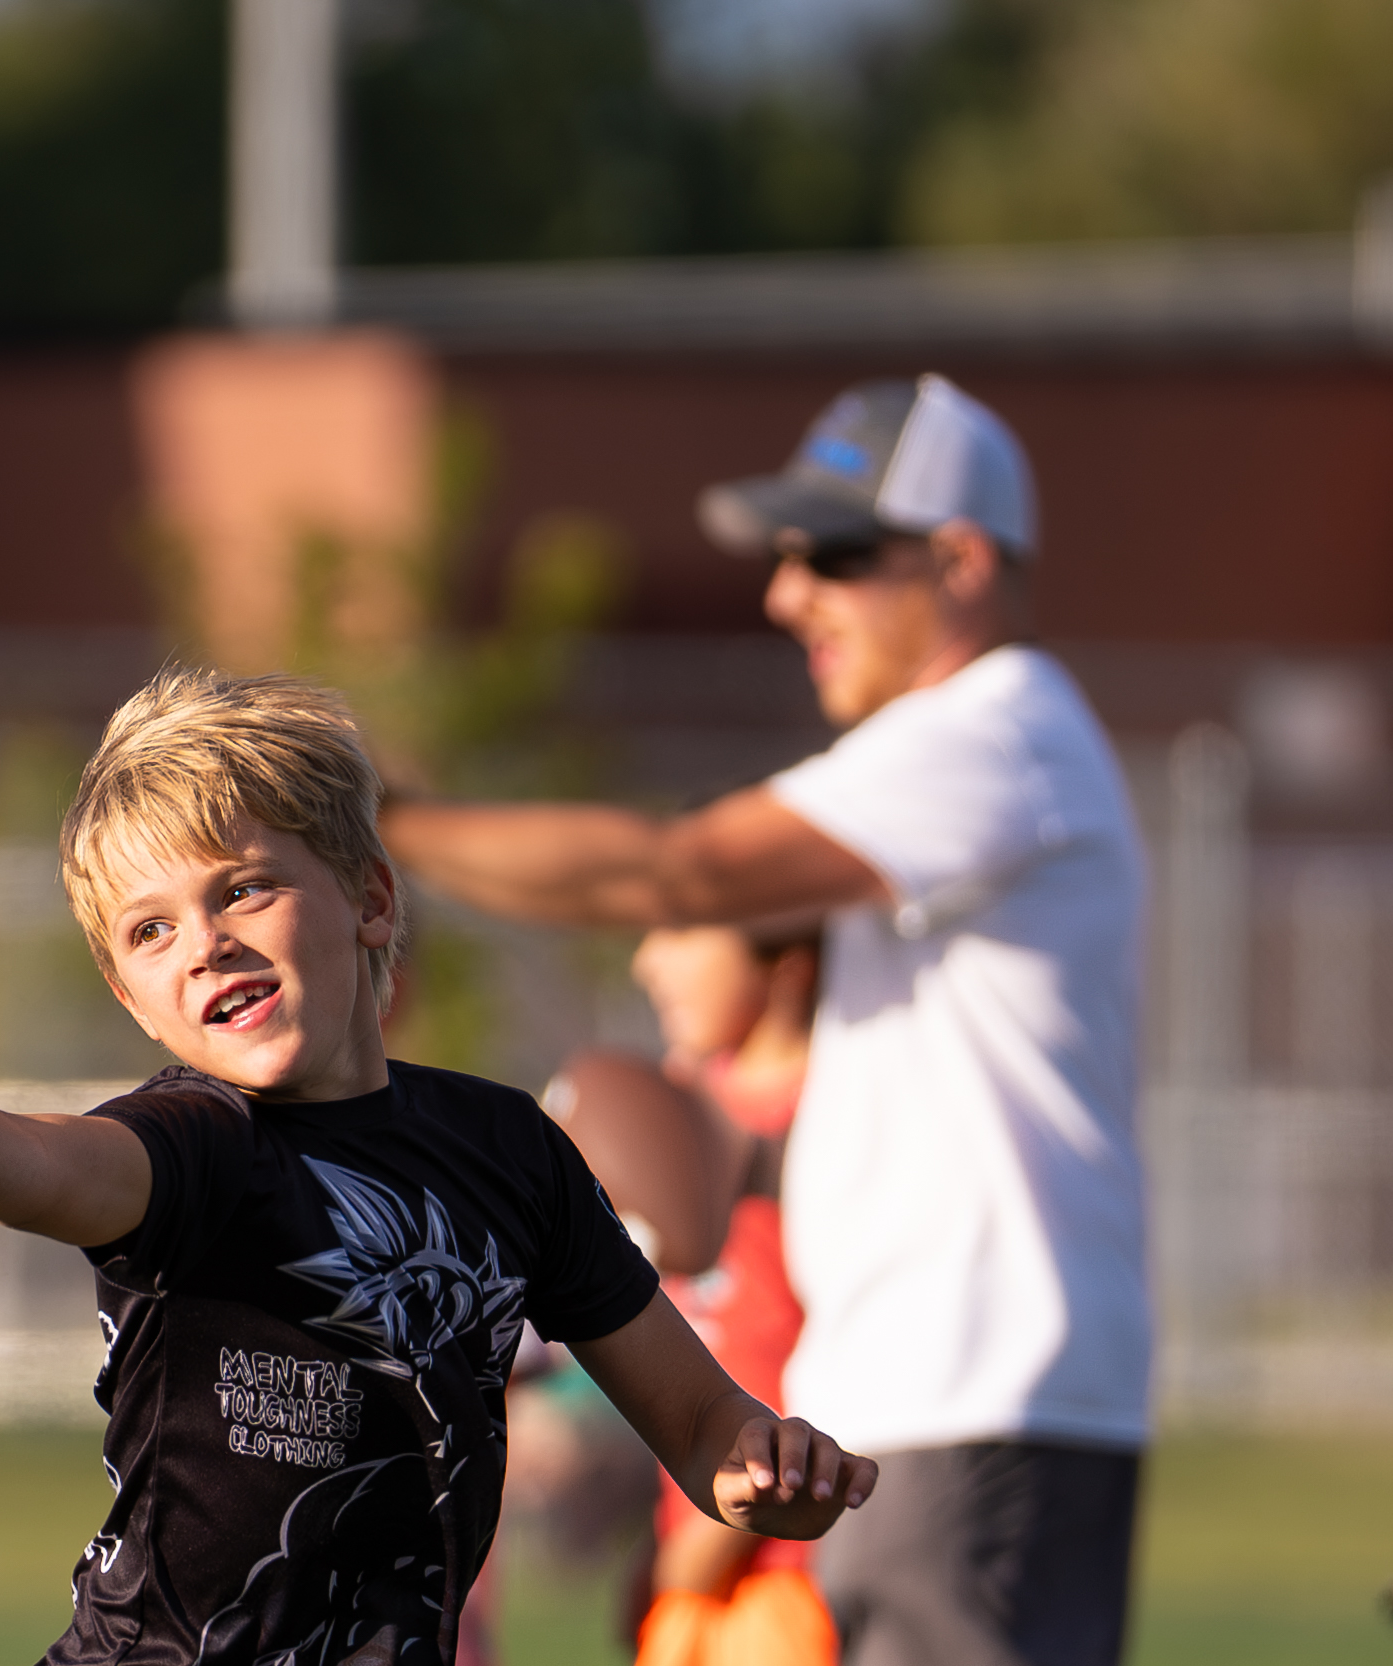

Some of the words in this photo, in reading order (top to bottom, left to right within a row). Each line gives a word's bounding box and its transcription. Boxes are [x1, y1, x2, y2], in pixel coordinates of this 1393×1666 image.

[219, 1346, 364, 1402] MENTAL
[214, 1382, 362, 1438] TOUGHNESS
[228, 1424, 346, 1469] CLOTHING
